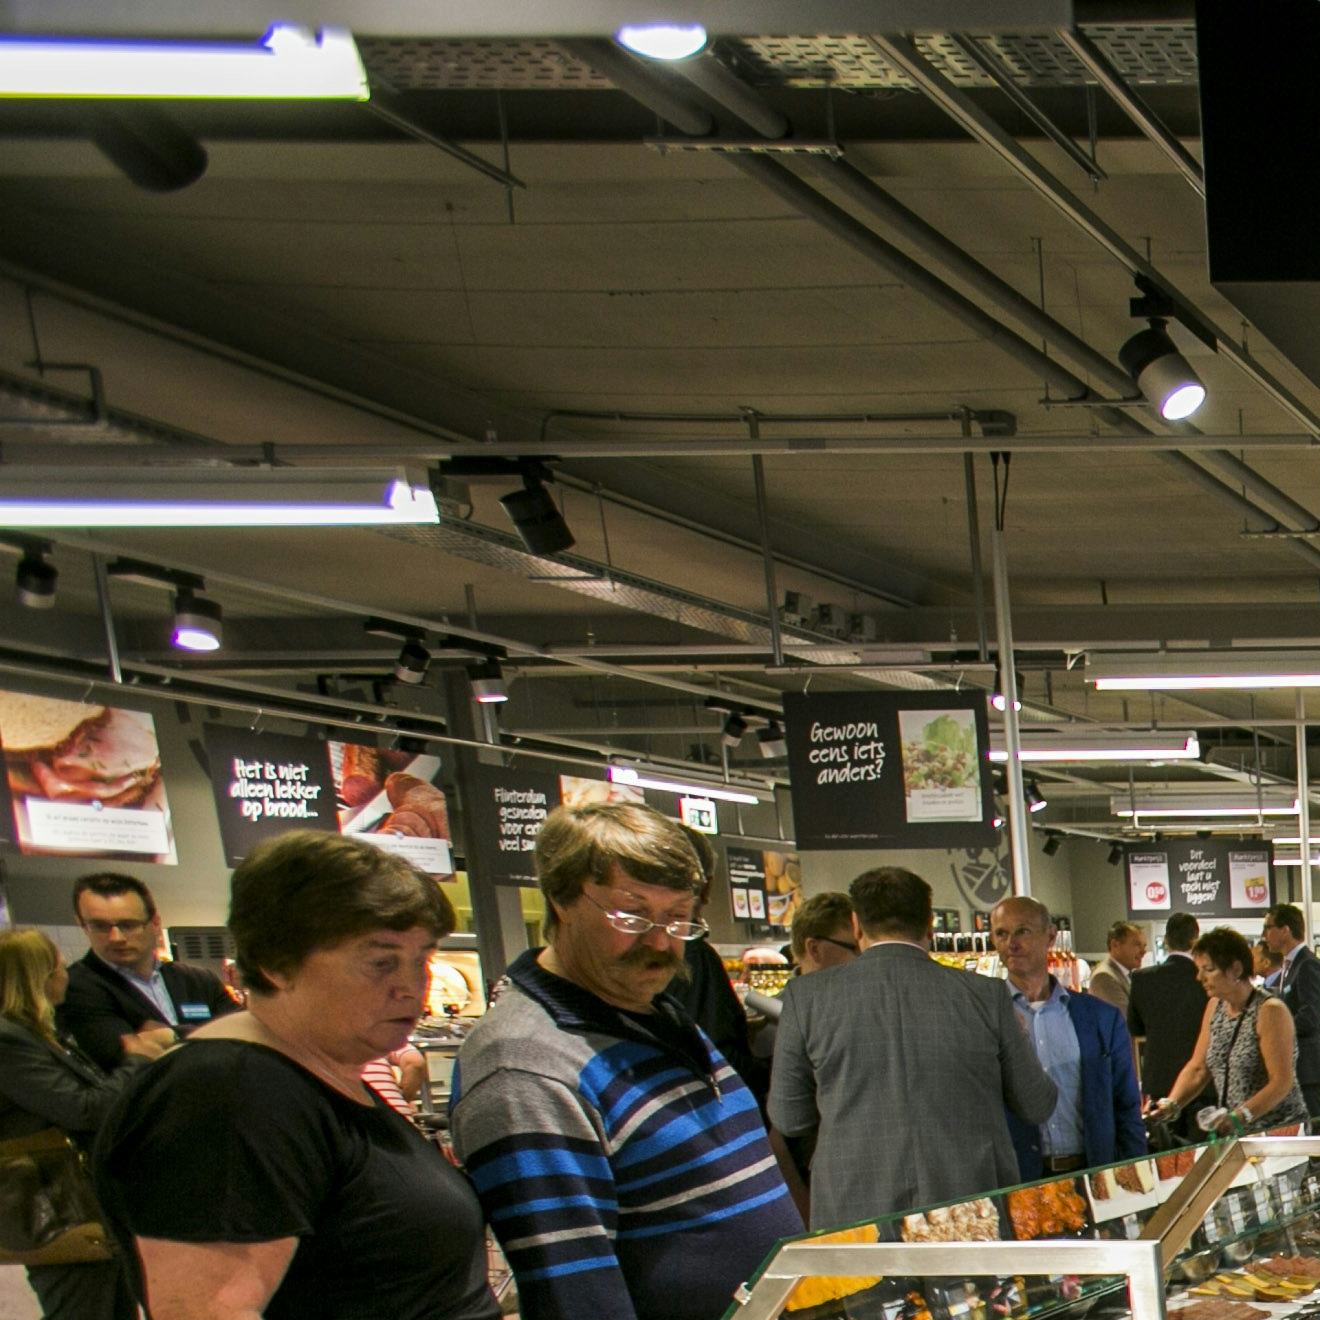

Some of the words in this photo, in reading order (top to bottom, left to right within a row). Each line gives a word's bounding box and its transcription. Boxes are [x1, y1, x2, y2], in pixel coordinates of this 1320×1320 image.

[810, 721, 879, 743] Gewoon
[808, 745, 849, 764] eens
[853, 742, 886, 761] iets
[233, 757, 263, 779] Het
[265, 762, 278, 780] is
[278, 762, 309, 782] niet
[817, 758, 884, 785] anders?
[229, 779, 274, 799] alleen
[274, 780, 321, 801] lekker
[240, 799, 262, 822] op
[263, 798, 319, 819] brood...
[499, 805, 548, 822] gesneden
[500, 823, 524, 835] voor
[499, 836, 520, 852] veel
[1178, 858, 1217, 872] voordeel
[1200, 880, 1221, 891] niet
